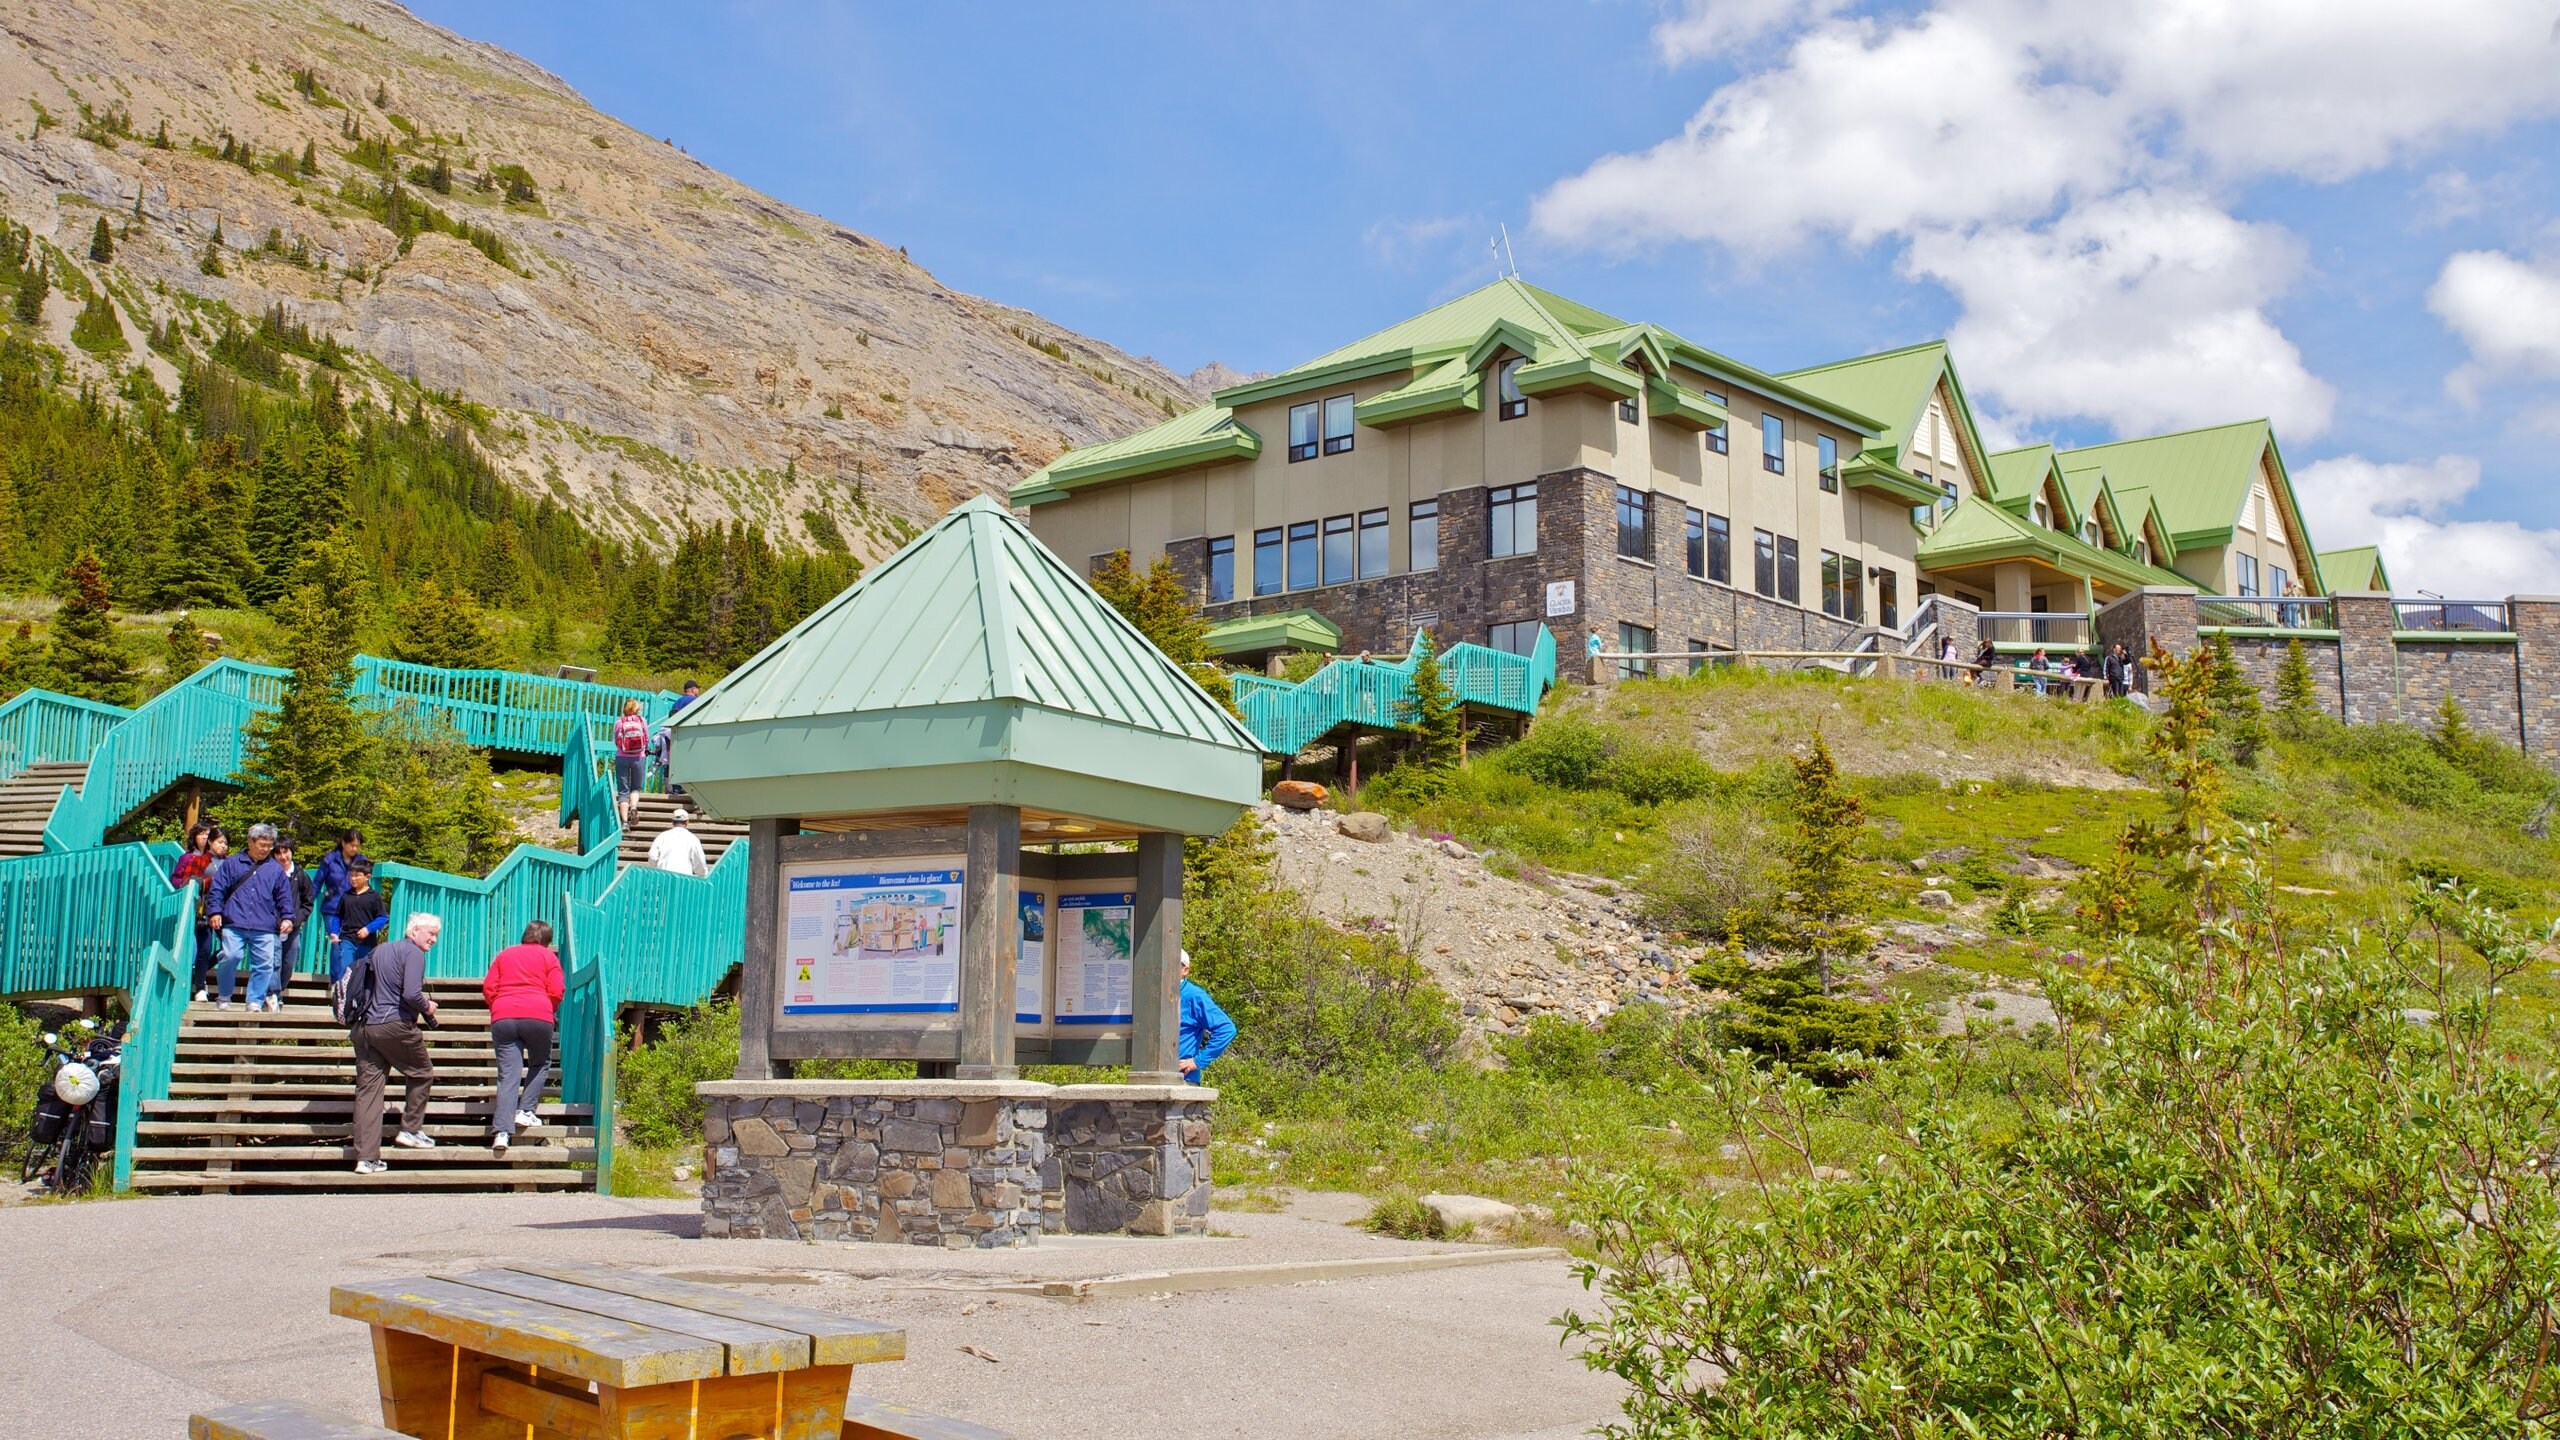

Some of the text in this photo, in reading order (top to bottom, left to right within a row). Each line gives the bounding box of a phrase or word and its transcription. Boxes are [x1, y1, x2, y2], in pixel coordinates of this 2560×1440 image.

[792, 880, 815, 889] Welcome
[821, 879, 830, 888] the
[831, 878, 841, 887] Ice!
[879, 876, 906, 885] Bienvenue
[906, 875, 919, 884] dans
